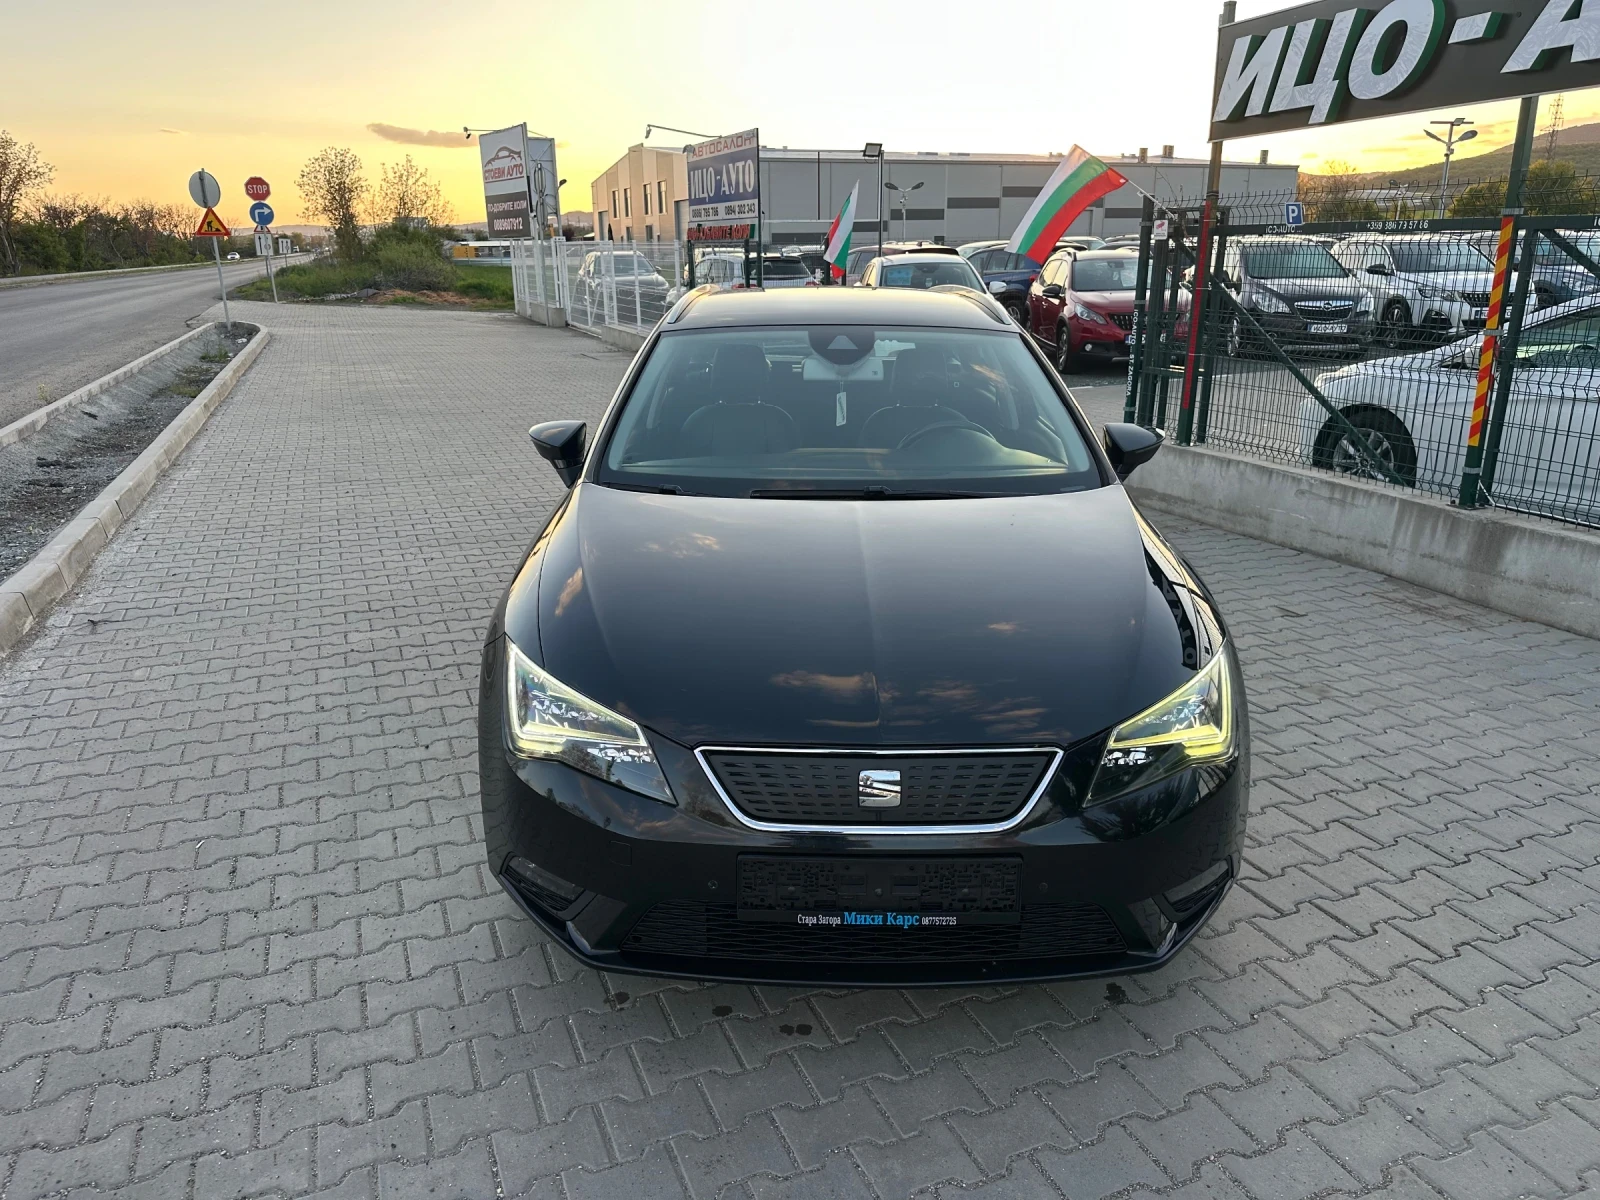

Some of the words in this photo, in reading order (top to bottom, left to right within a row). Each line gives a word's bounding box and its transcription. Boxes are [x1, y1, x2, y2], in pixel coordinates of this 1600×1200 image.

[692, 135, 752, 158] АВТОСАЛОН
[506, 163, 524, 178] АУТО
[247, 184, 268, 194] STOP
[690, 160, 755, 203] ИЦО-АУТО
[1288, 205, 1298, 223] P
[1126, 365, 1134, 396] ZAGORA
[797, 914, 817, 926] Стара
[818, 914, 841, 927] Загора
[844, 911, 883, 925] Мики
[886, 912, 920, 929] Карс
